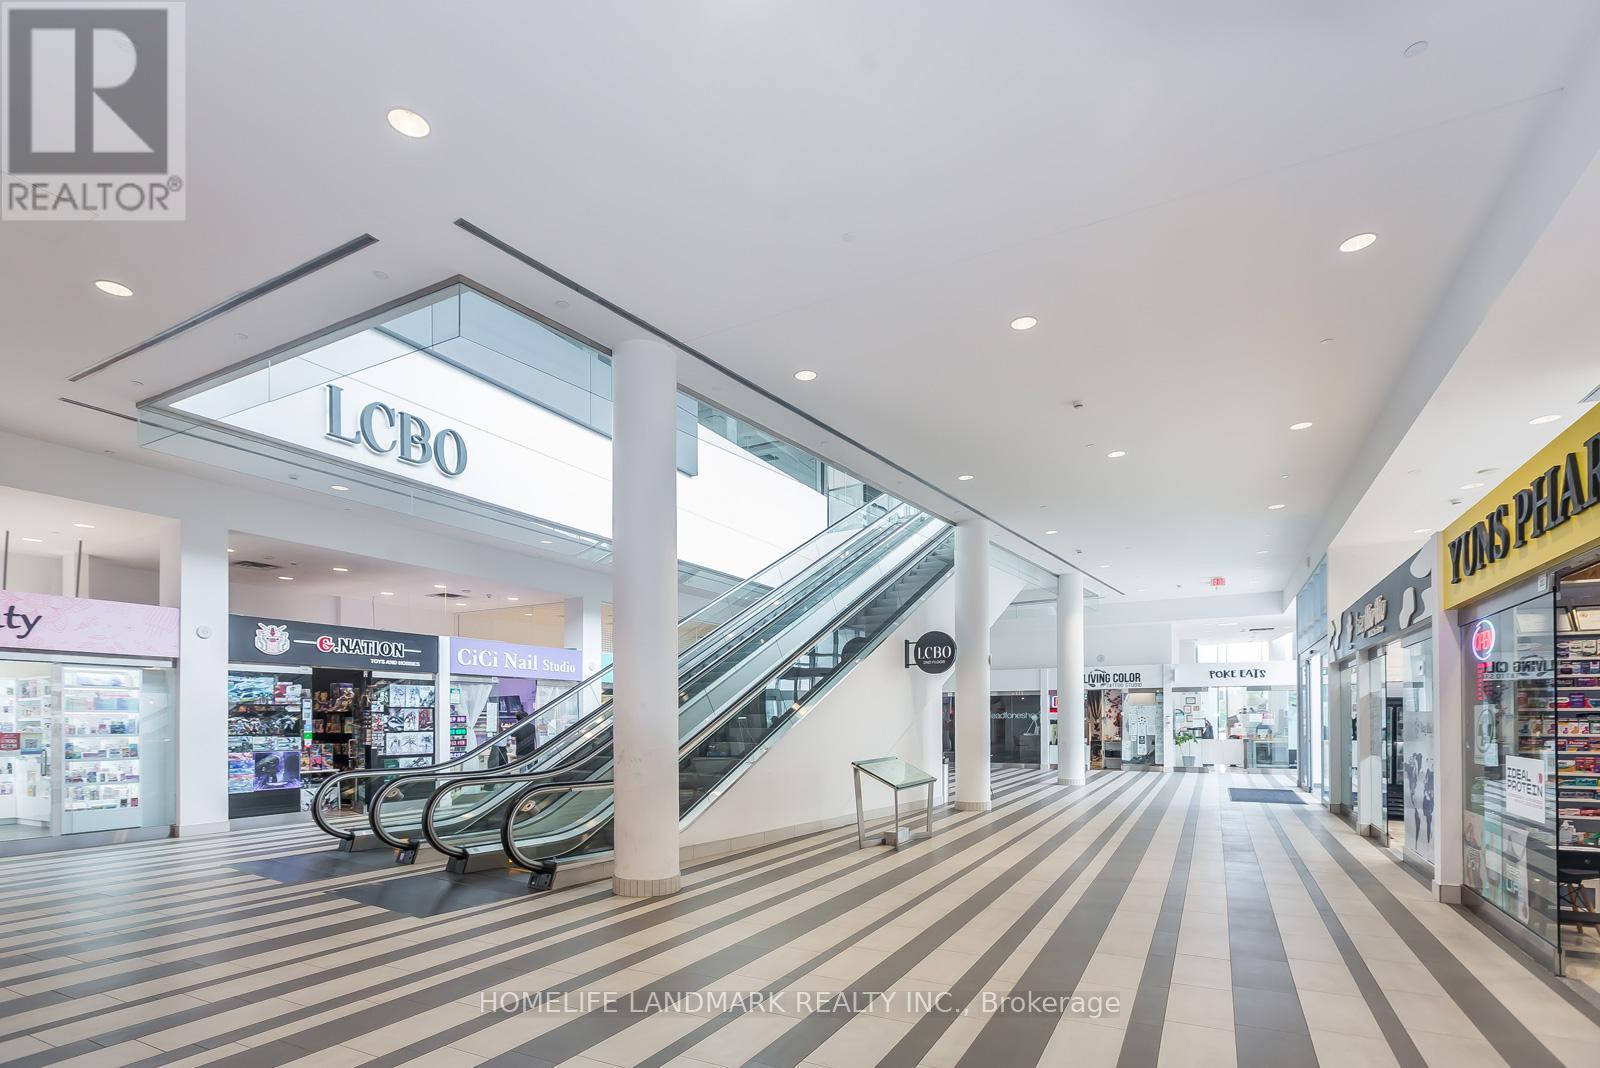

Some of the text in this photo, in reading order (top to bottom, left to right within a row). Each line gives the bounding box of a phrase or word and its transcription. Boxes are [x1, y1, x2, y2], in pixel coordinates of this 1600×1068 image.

[325, 383, 468, 478] LCBO
[0, 605, 43, 640] ty
[457, 648, 576, 673] CiCi Nail Studio
[917, 645, 952, 660] LCBO
[1083, 672, 1141, 683] LIVING COLOR
[1209, 669, 1266, 679] POKE EATS
[1507, 767, 1532, 782] IDEAL
[1507, 779, 1543, 798] PROTEIN
